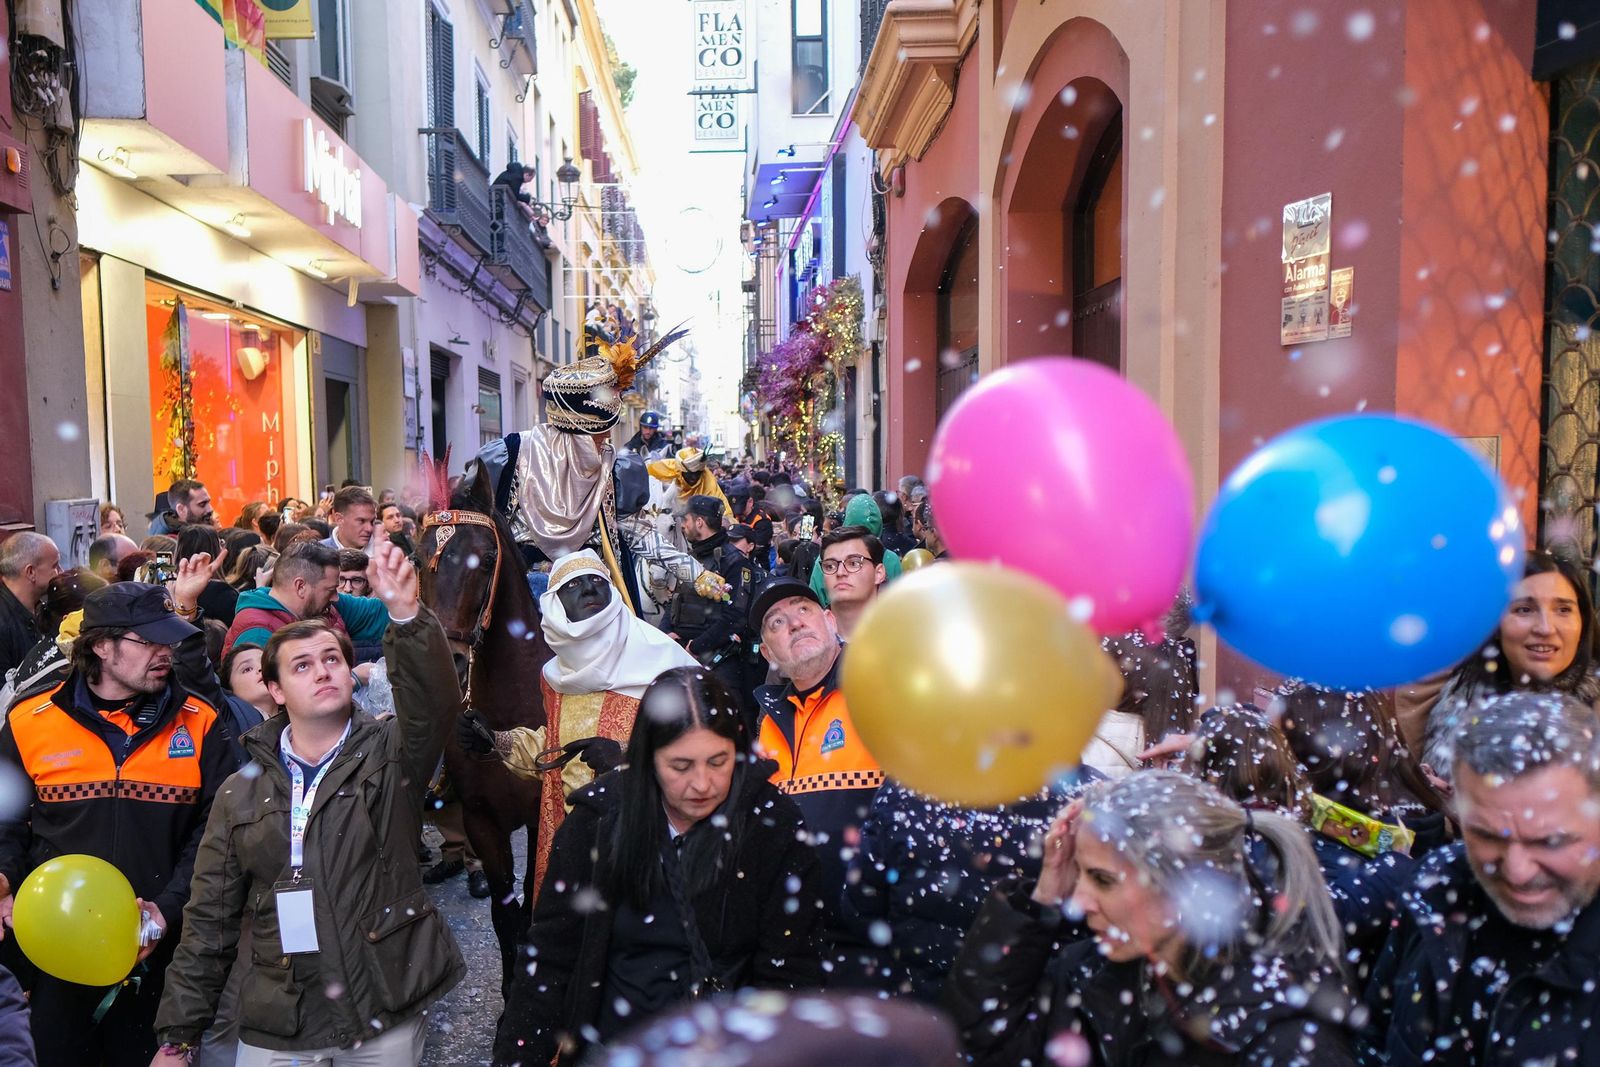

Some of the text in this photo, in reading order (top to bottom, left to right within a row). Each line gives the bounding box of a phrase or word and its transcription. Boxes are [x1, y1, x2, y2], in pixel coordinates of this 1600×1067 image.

[698, 12, 743, 32] FLA
[697, 32, 742, 46] MEN
[698, 46, 742, 67] CO
[697, 100, 735, 111] MEN
[698, 112, 735, 129] CO
[1285, 263, 1326, 284] Alarma
[262, 411, 279, 512] Miph
